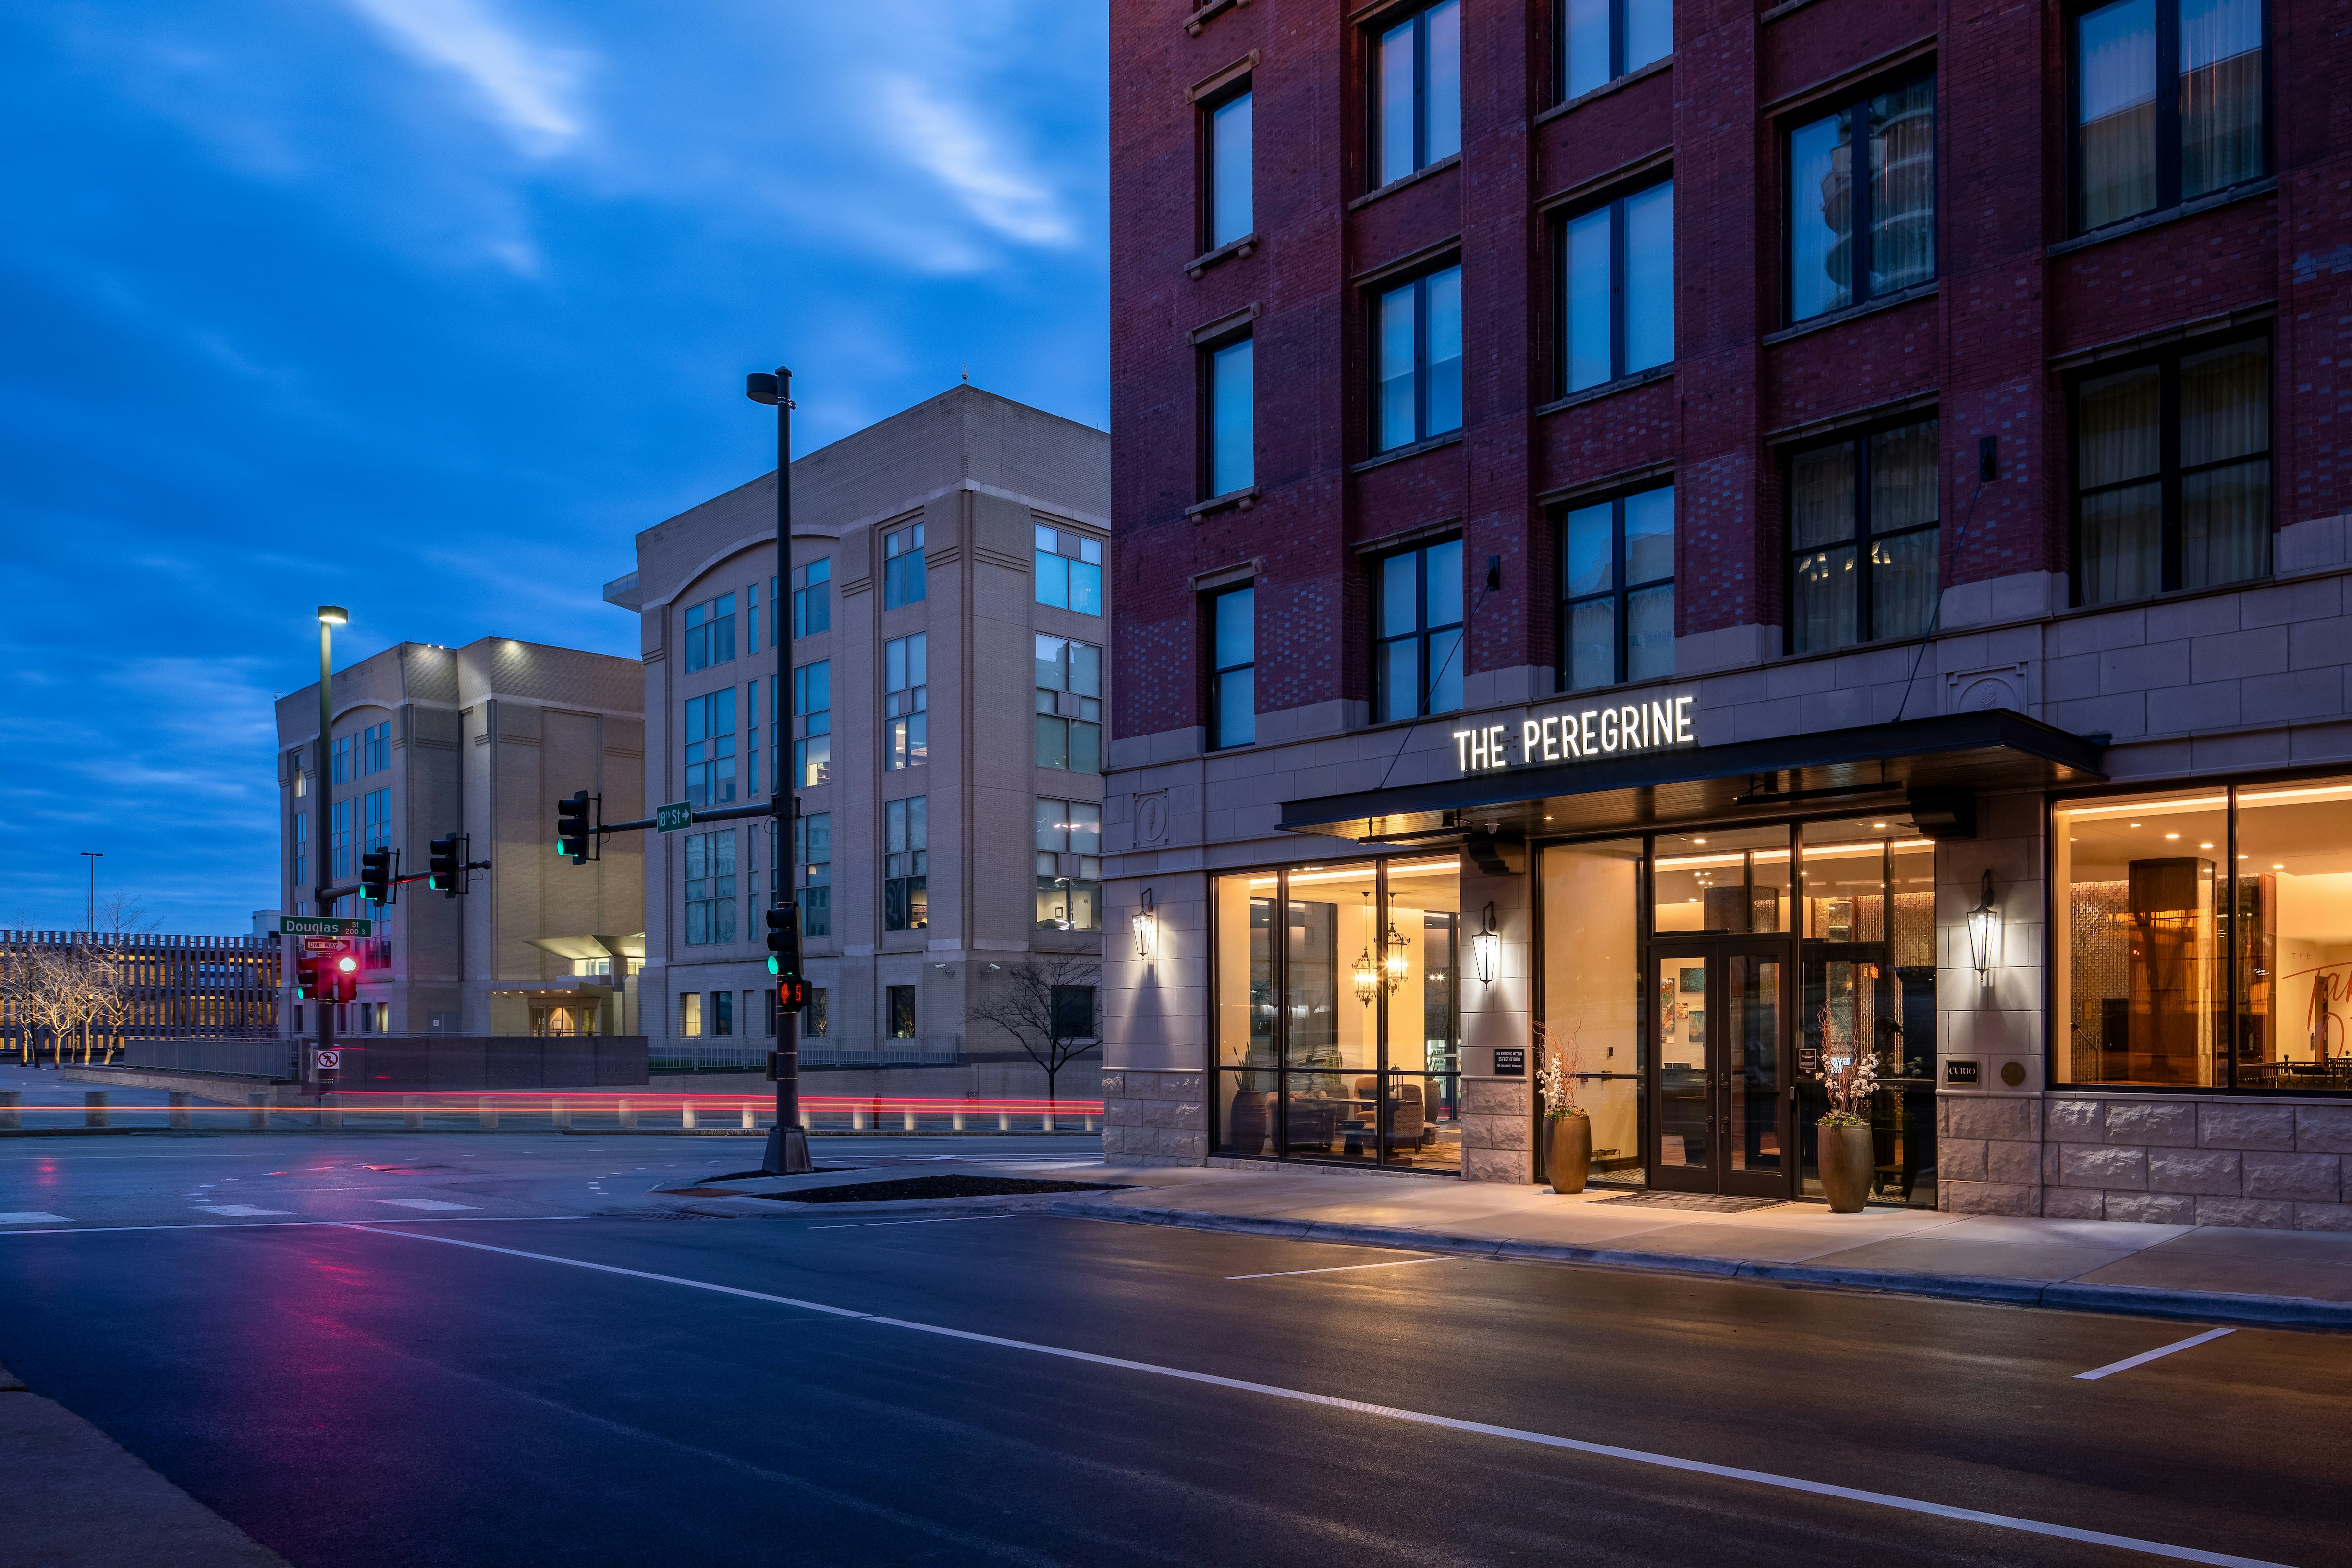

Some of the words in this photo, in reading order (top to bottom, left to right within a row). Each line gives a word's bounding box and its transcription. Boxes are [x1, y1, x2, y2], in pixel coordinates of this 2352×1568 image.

[1453, 725, 1507, 772] THE
[1523, 696, 1694, 763] PEREGRINE
[659, 811, 670, 827] 18th
[672, 809, 680, 824] St
[286, 920, 339, 935] Douglas
